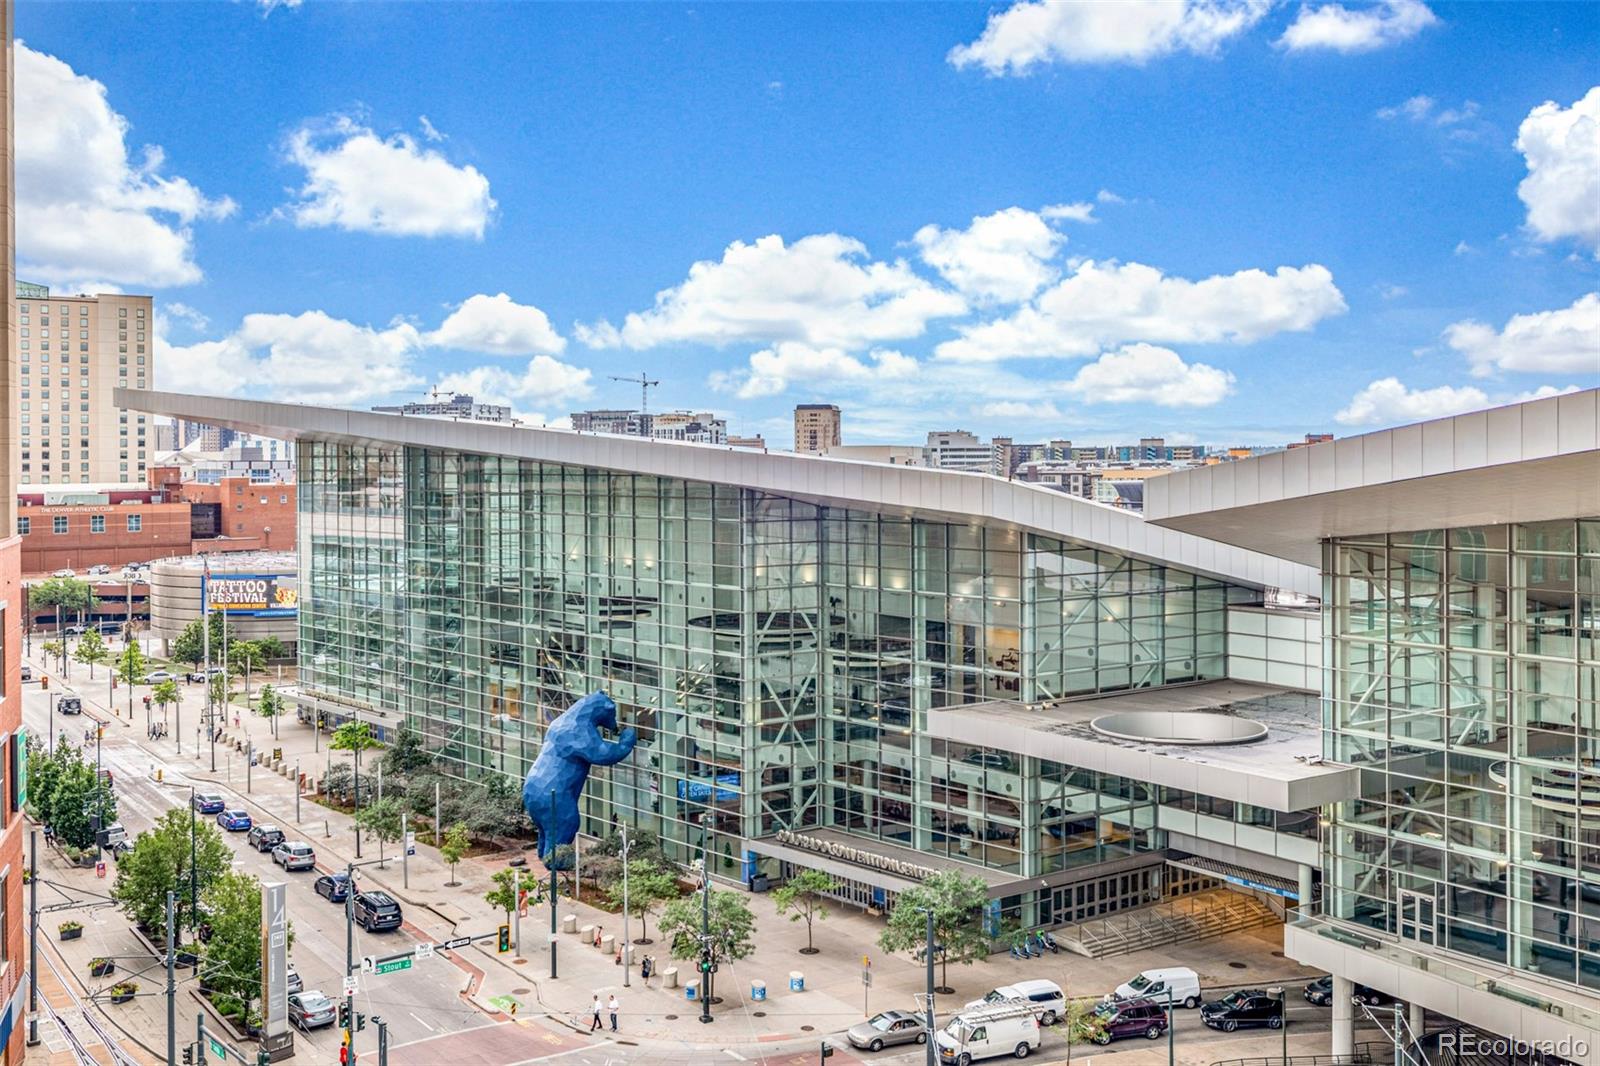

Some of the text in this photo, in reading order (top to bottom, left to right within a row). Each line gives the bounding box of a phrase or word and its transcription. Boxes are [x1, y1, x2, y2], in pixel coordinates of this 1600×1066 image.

[208, 580, 267, 593] TATTOO
[210, 593, 267, 603] FESTIVAL
[829, 843, 899, 872] CONVENTION
[383, 962, 402, 972] Stout
